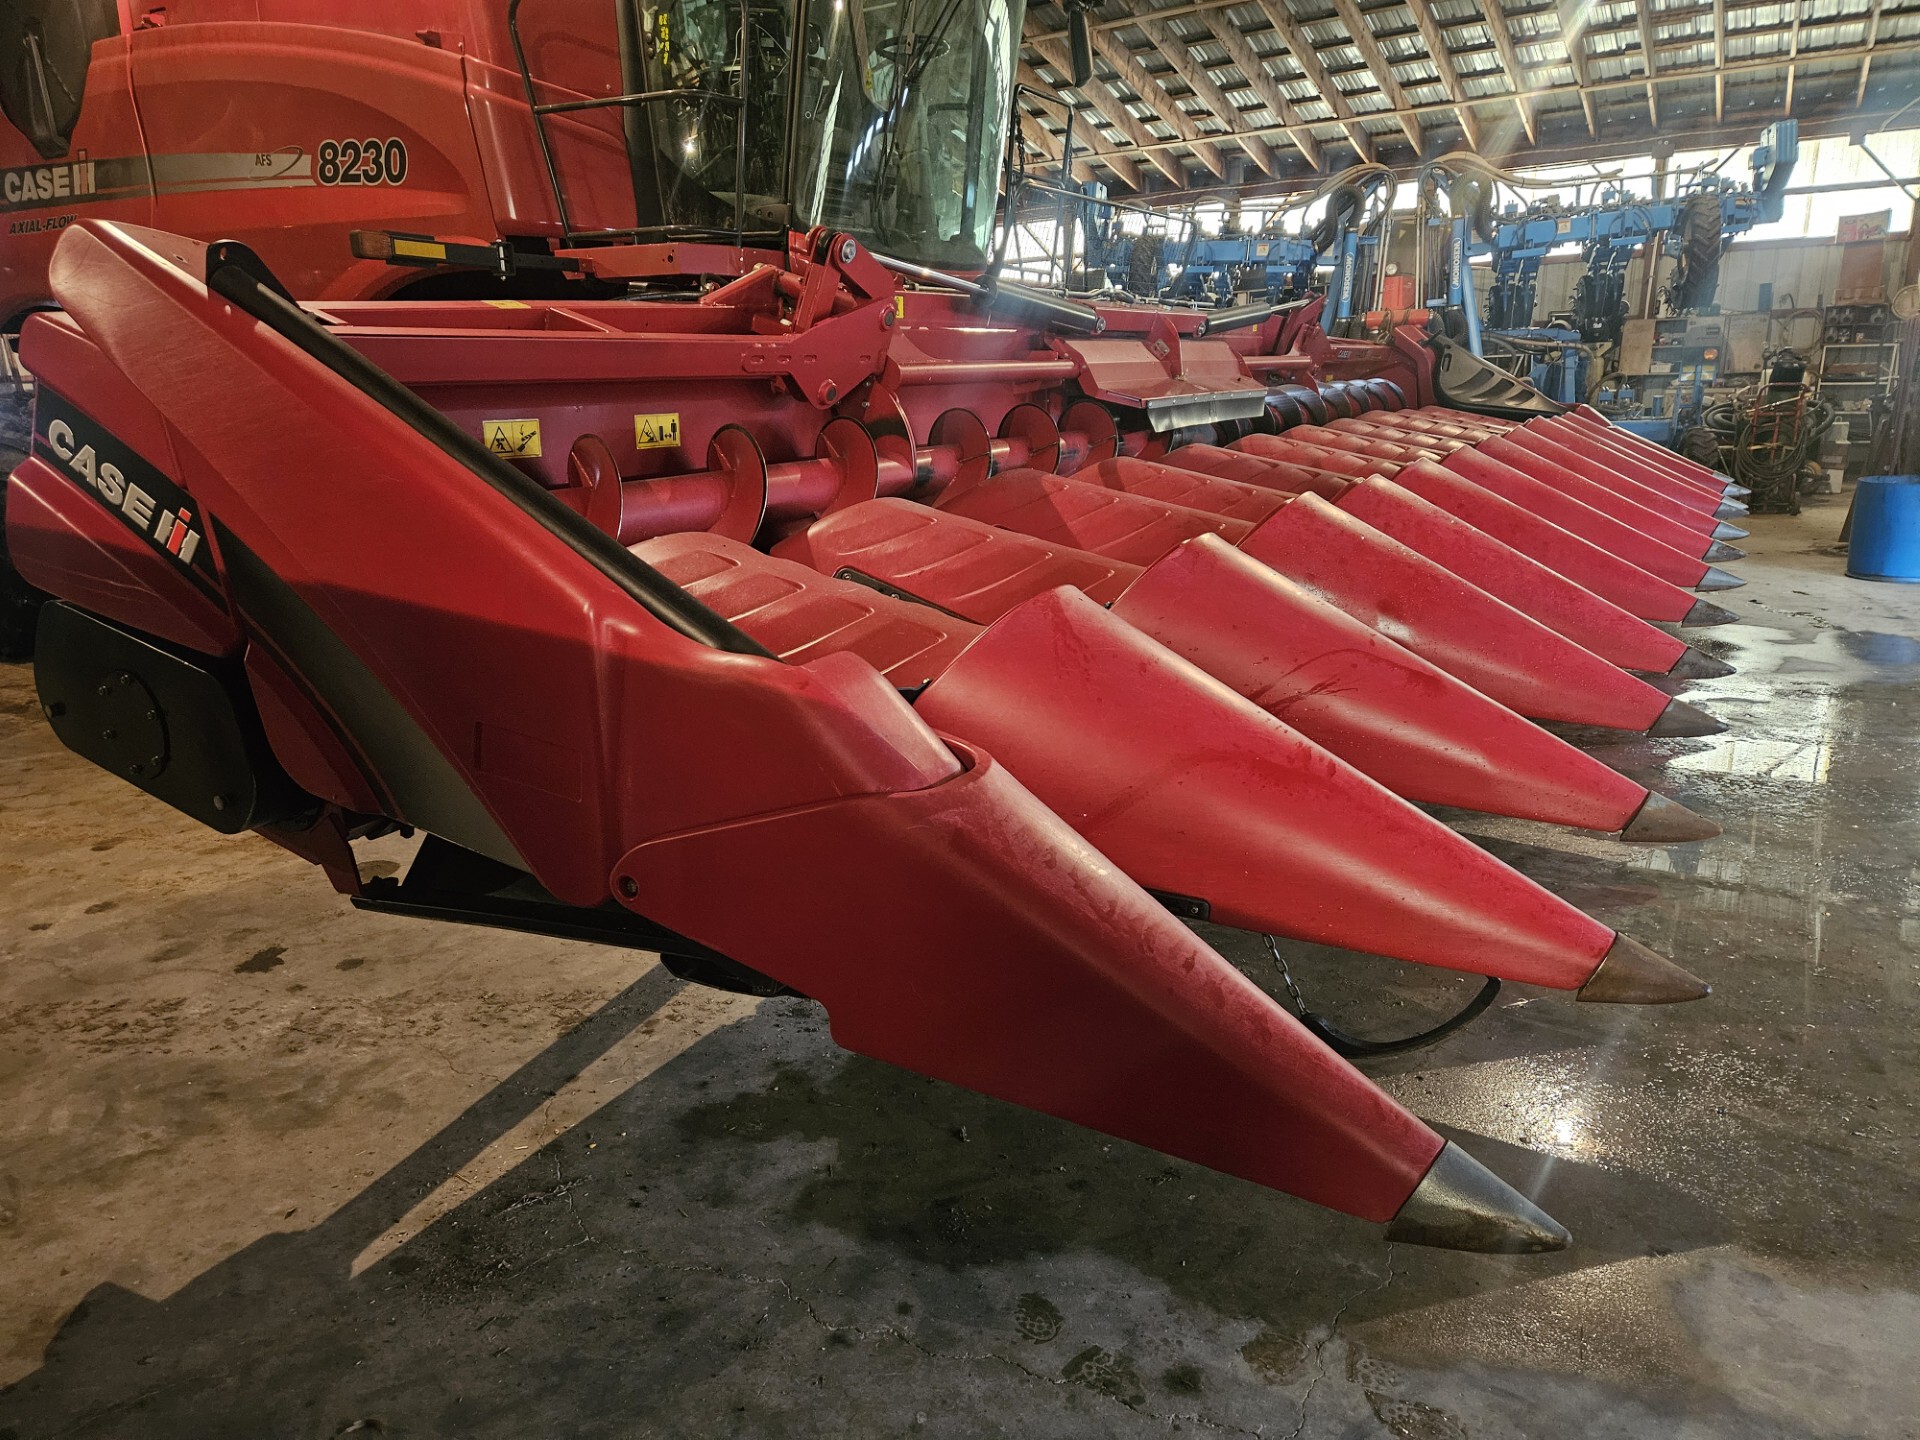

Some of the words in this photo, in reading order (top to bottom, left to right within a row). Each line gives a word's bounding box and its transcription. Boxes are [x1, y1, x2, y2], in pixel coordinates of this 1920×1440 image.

[255, 154, 272, 166] AFS
[318, 137, 408, 186] 8230
[5, 167, 70, 202] CASE
[1342, 255, 1352, 300] MONOSEM
[1452, 240, 1460, 286] MONOSEM
[48, 419, 157, 531] CASE
